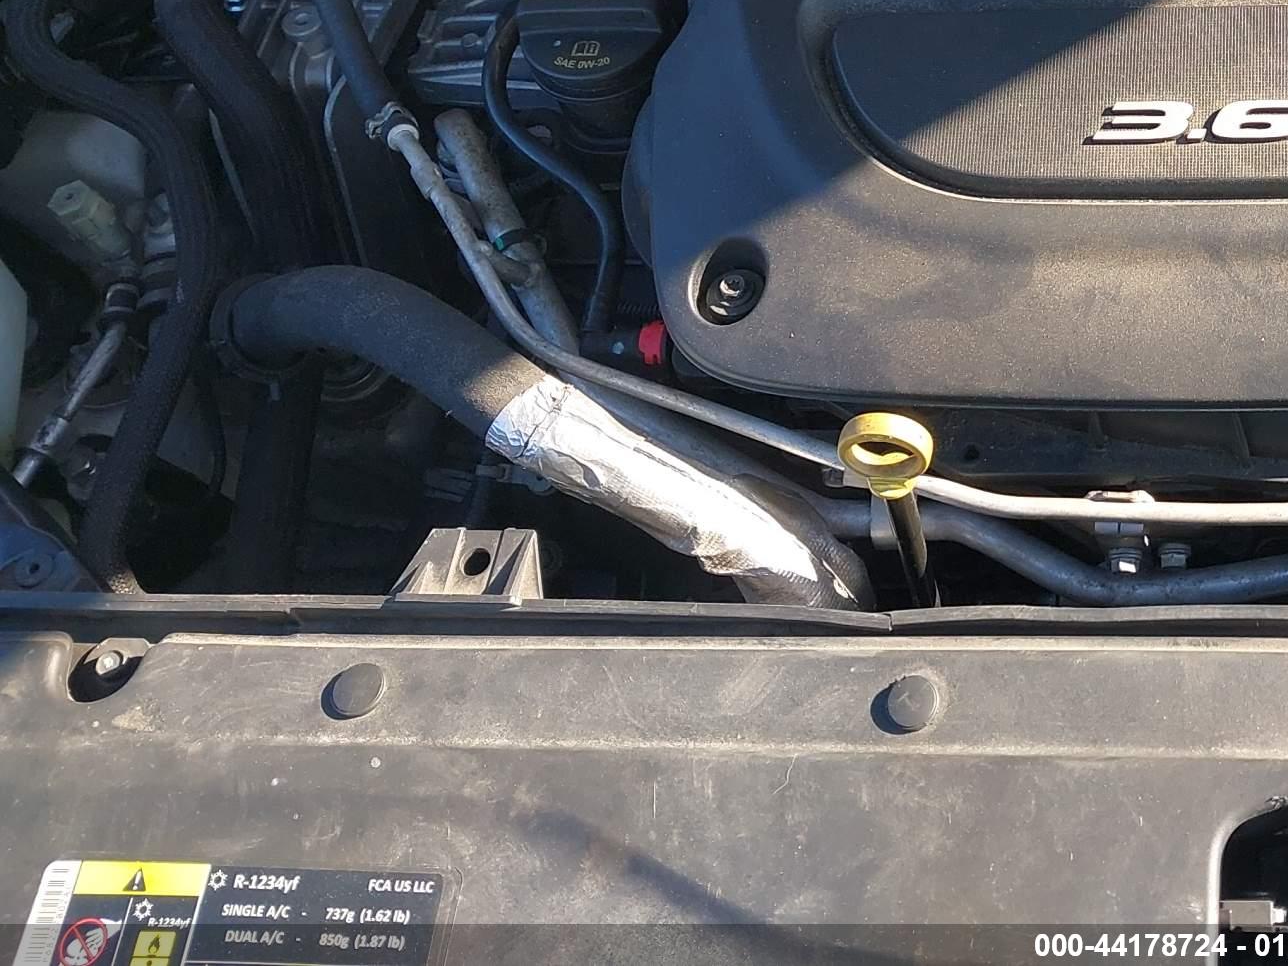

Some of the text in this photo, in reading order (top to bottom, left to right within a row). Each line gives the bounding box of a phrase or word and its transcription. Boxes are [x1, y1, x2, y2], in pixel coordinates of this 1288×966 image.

[553, 56, 611, 70] SAE 0W-20
[233, 874, 300, 893] R-1234yf
[368, 878, 434, 893] FCA US LLC
[222, 903, 264, 918] SINGLE
[265, 904, 291, 920] A/C
[325, 907, 355, 923] 737g
[359, 908, 391, 923] (1.62
[392, 908, 410, 925] lb)
[148, 917, 192, 930] R-1234yf
[225, 930, 259, 943] DUAL
[260, 930, 284, 946] A/C
[319, 933, 349, 949] 850g
[354, 934, 386, 949] (1.87
[387, 935, 406, 952] lb)
